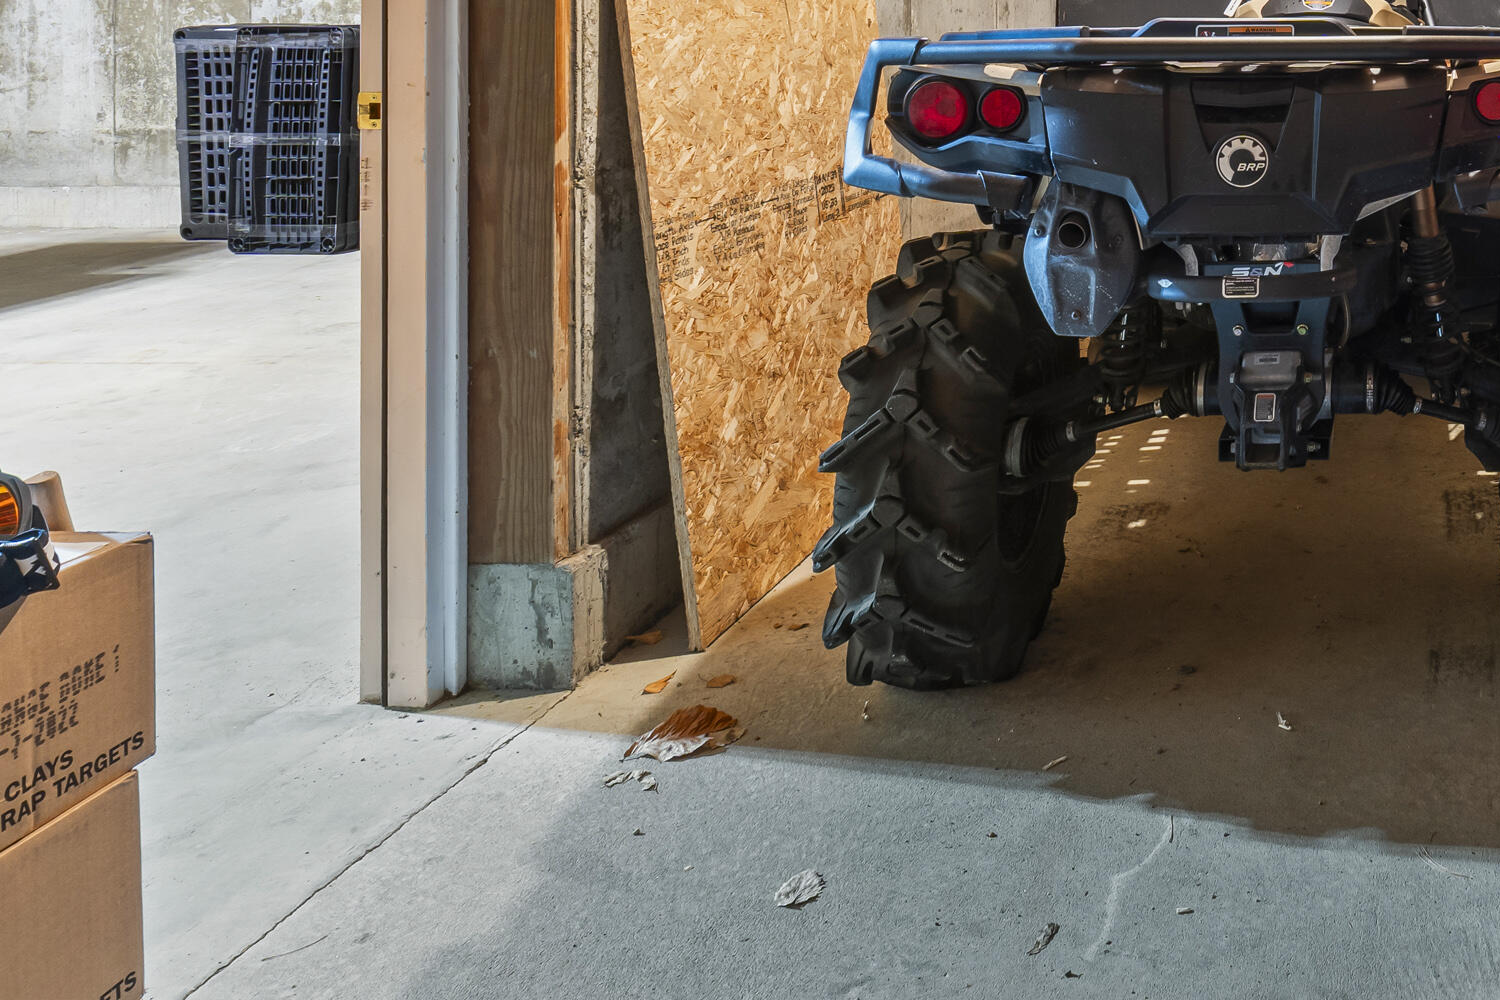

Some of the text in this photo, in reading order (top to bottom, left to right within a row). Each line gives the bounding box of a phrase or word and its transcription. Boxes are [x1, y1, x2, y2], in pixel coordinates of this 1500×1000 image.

[1237, 162, 1265, 172] BRP
[1231, 262, 1285, 276] S&N
[0, 731, 145, 832] RAP TARGETS
[4, 749, 74, 802] CLAYS
[99, 970, 137, 1000] TS
